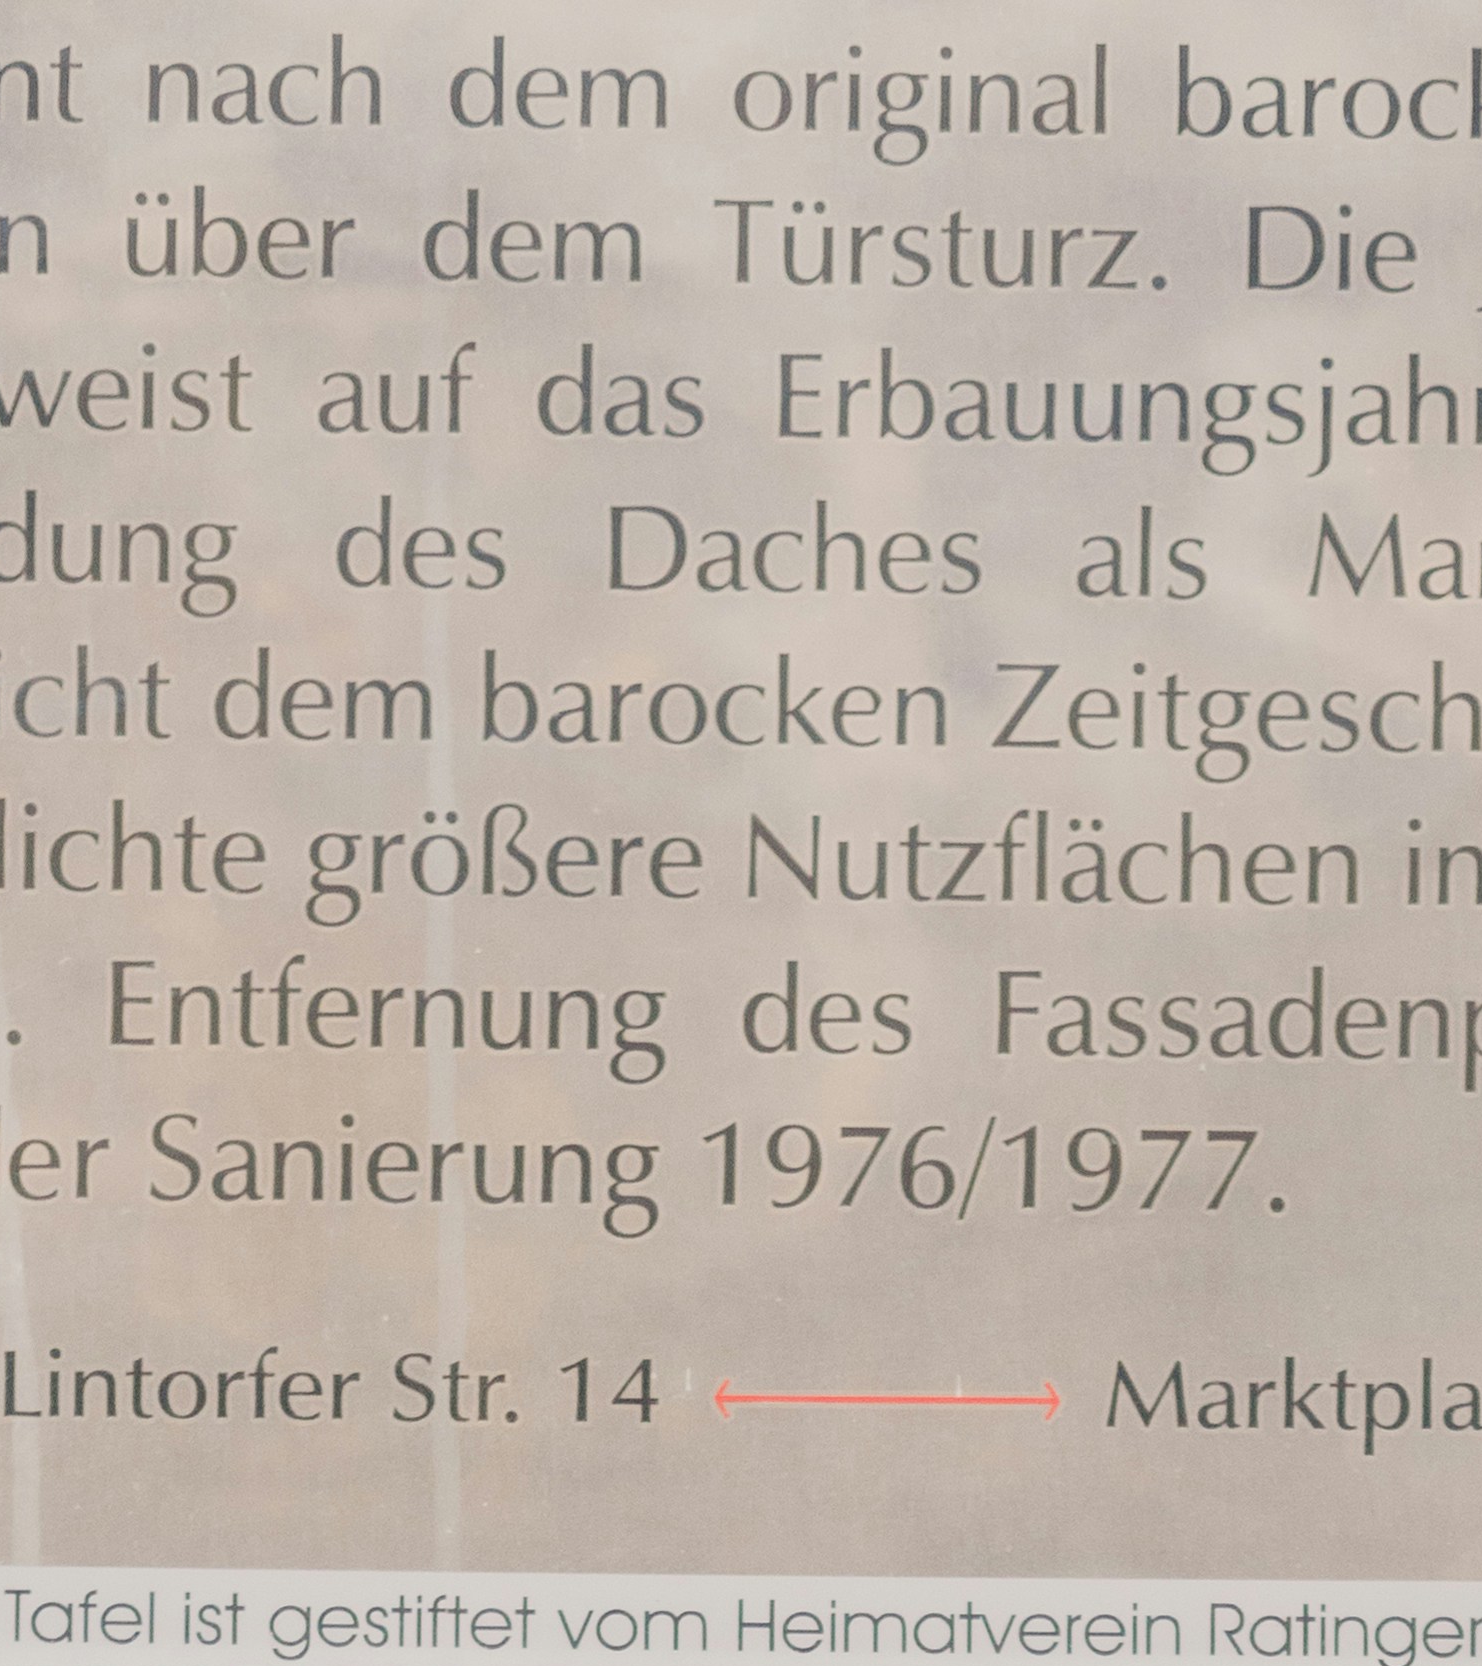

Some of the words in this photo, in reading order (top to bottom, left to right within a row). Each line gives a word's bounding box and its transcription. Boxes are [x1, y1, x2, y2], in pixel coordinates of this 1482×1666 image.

[146, 31, 383, 128] nach
[448, 33, 669, 131] dem
[732, 41, 1109, 168] original
[125, 183, 357, 282] über
[422, 186, 643, 285] dem
[712, 197, 1169, 293] Türsturz.
[1245, 202, 1419, 295] Die
[316, 339, 478, 436] auf
[536, 341, 706, 440] das
[335, 493, 508, 592] des
[607, 498, 983, 596] Daches
[1075, 503, 1208, 602] als
[212, 645, 433, 742] dem
[481, 647, 948, 749] barocken
[304, 801, 704, 929] größere
[746, 807, 1359, 907] Nutzflächen
[109, 952, 668, 1086] Entfernung
[741, 958, 913, 1057] des
[148, 1112, 661, 1240] Sanierung
[701, 1114, 1287, 1222] 1976/1977.
[2, 1344, 362, 1422] Lintorfer
[391, 1351, 520, 1425] Str.
[559, 1355, 661, 1424] 14
[3, 1588, 156, 1646] Tafel
[183, 1591, 246, 1646] ist
[268, 1593, 537, 1662] gestiftet
[557, 1607, 708, 1652] vom
[737, 1598, 1181, 1657] Heimatverein
